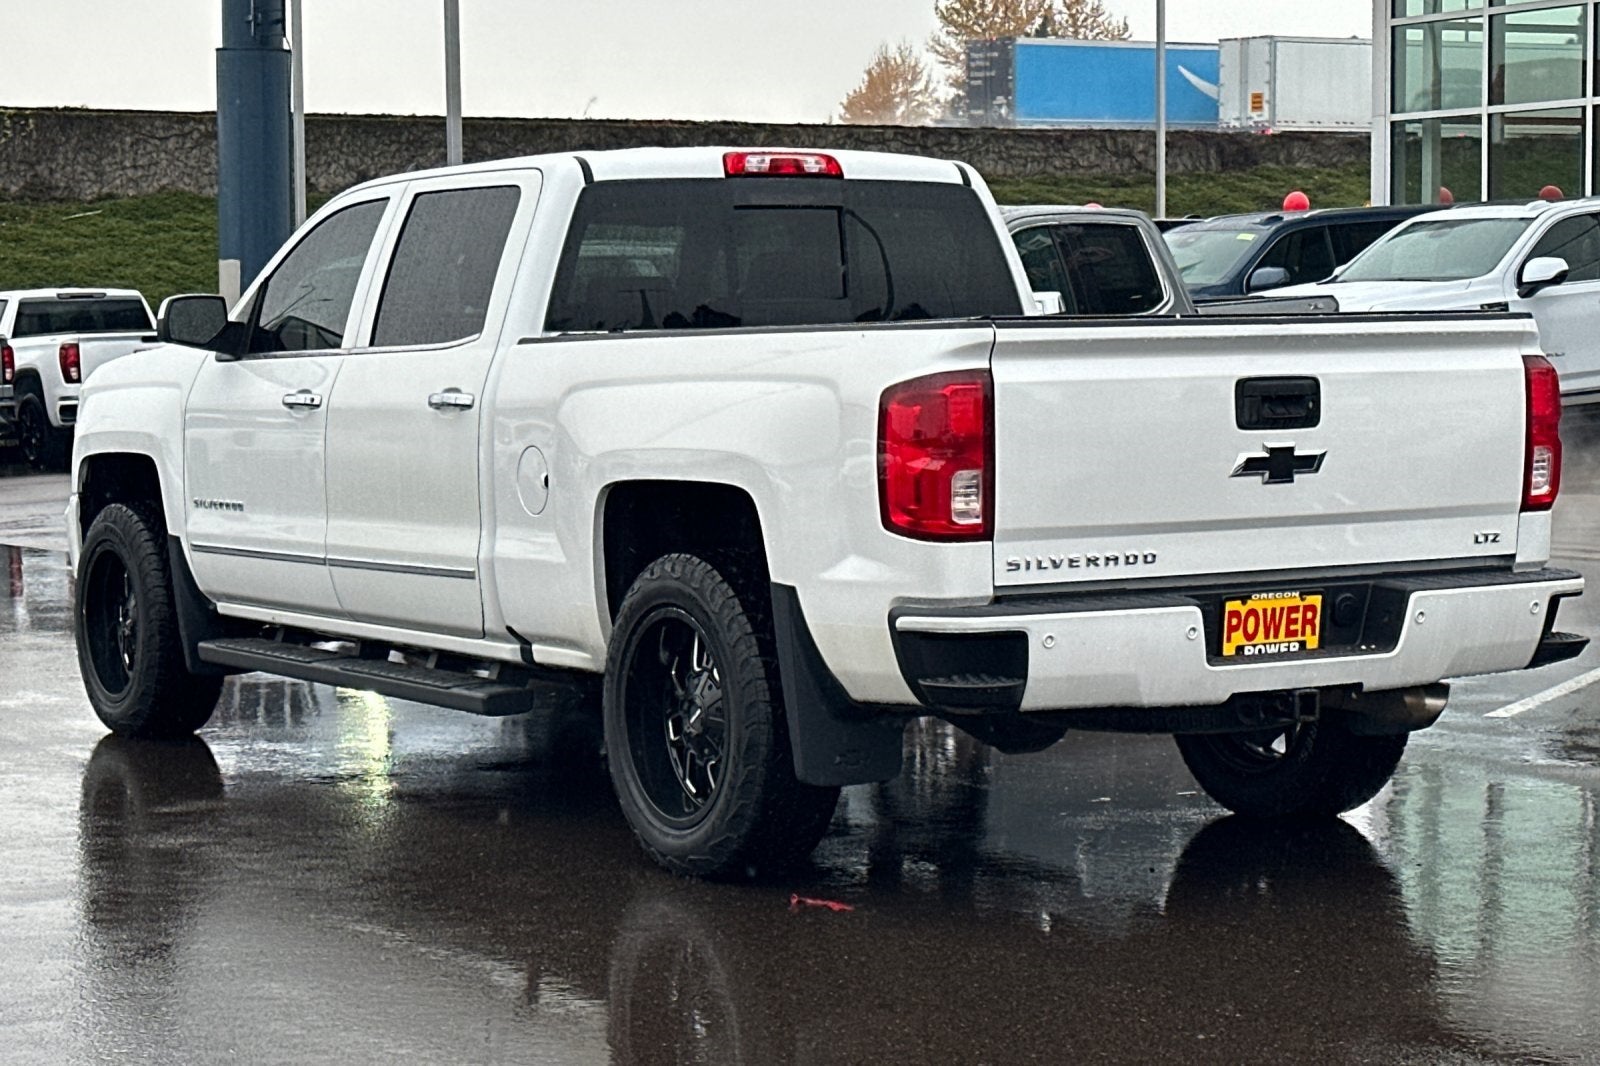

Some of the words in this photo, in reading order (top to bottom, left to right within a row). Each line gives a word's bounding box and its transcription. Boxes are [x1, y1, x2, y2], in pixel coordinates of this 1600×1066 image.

[1474, 531, 1501, 544] LTZ
[1006, 551, 1157, 572] SILVERADO
[1251, 591, 1300, 600] OREGON
[1226, 604, 1318, 643] POWER
[1244, 642, 1300, 656] POWER
